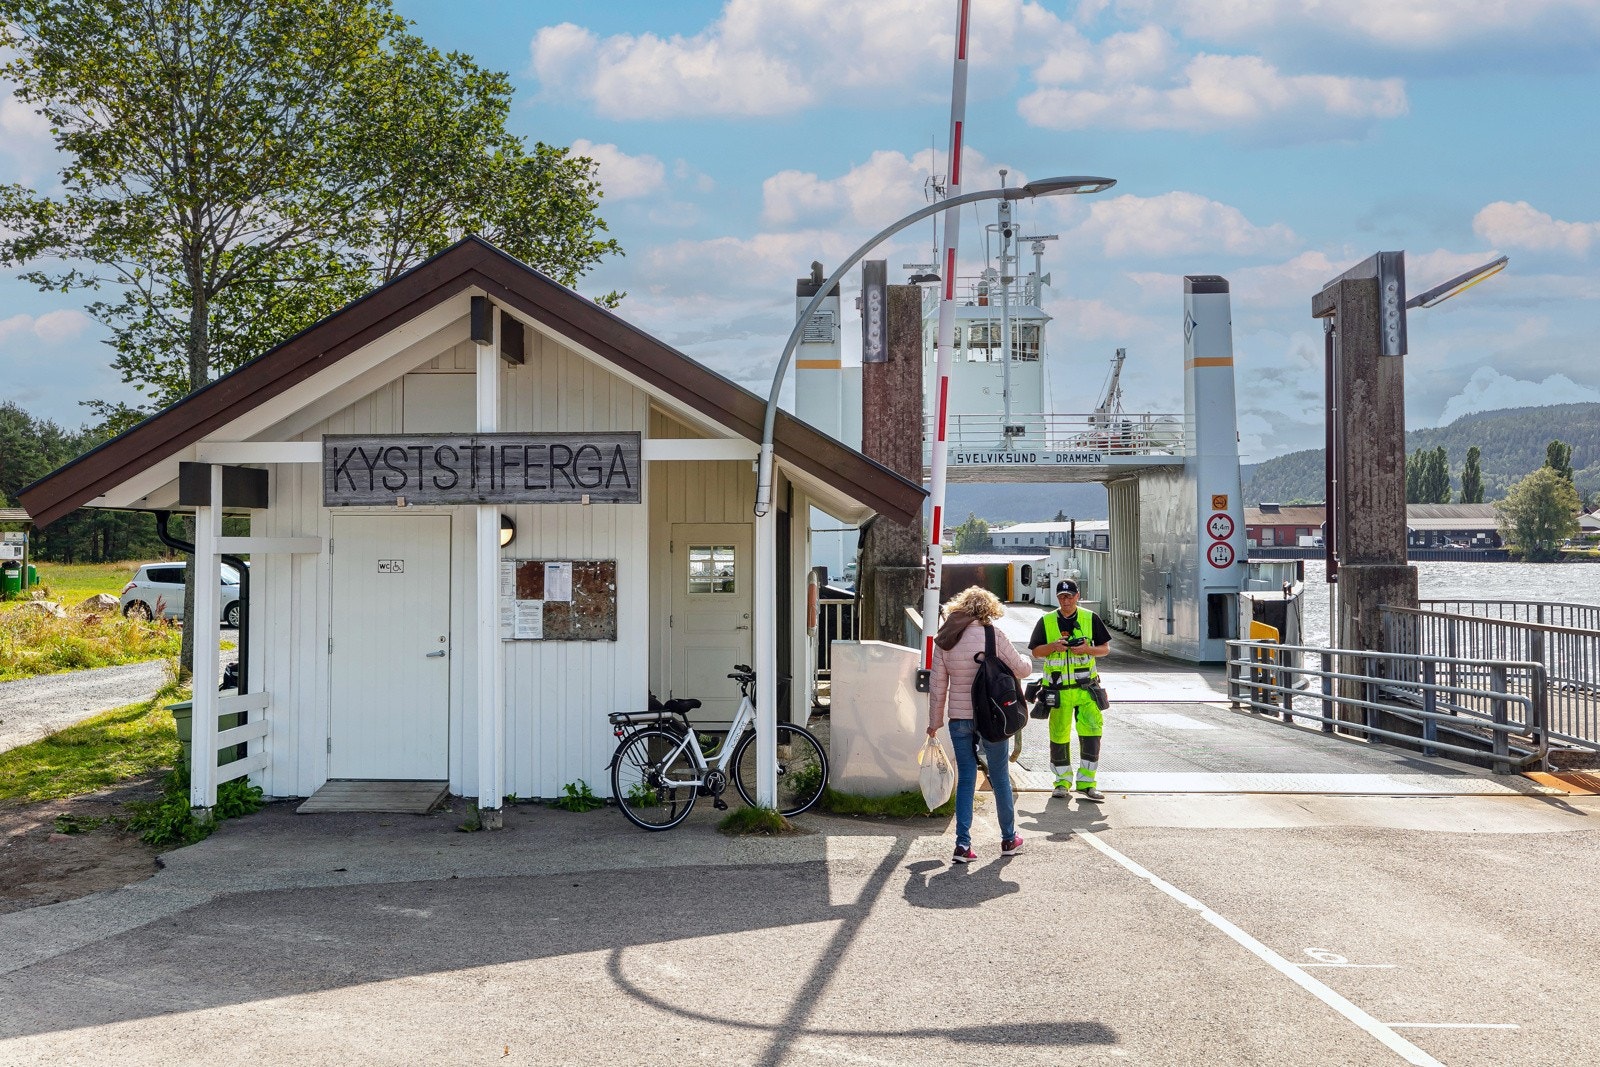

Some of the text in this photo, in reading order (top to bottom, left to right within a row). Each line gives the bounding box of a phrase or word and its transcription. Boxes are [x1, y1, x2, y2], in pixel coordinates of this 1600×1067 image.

[957, 453, 1037, 464] SVELVIKSUND
[1056, 453, 1101, 463] DRAMMEN
[333, 443, 632, 492] KYSTSTIFERGA
[1303, 947, 1349, 963] 6
